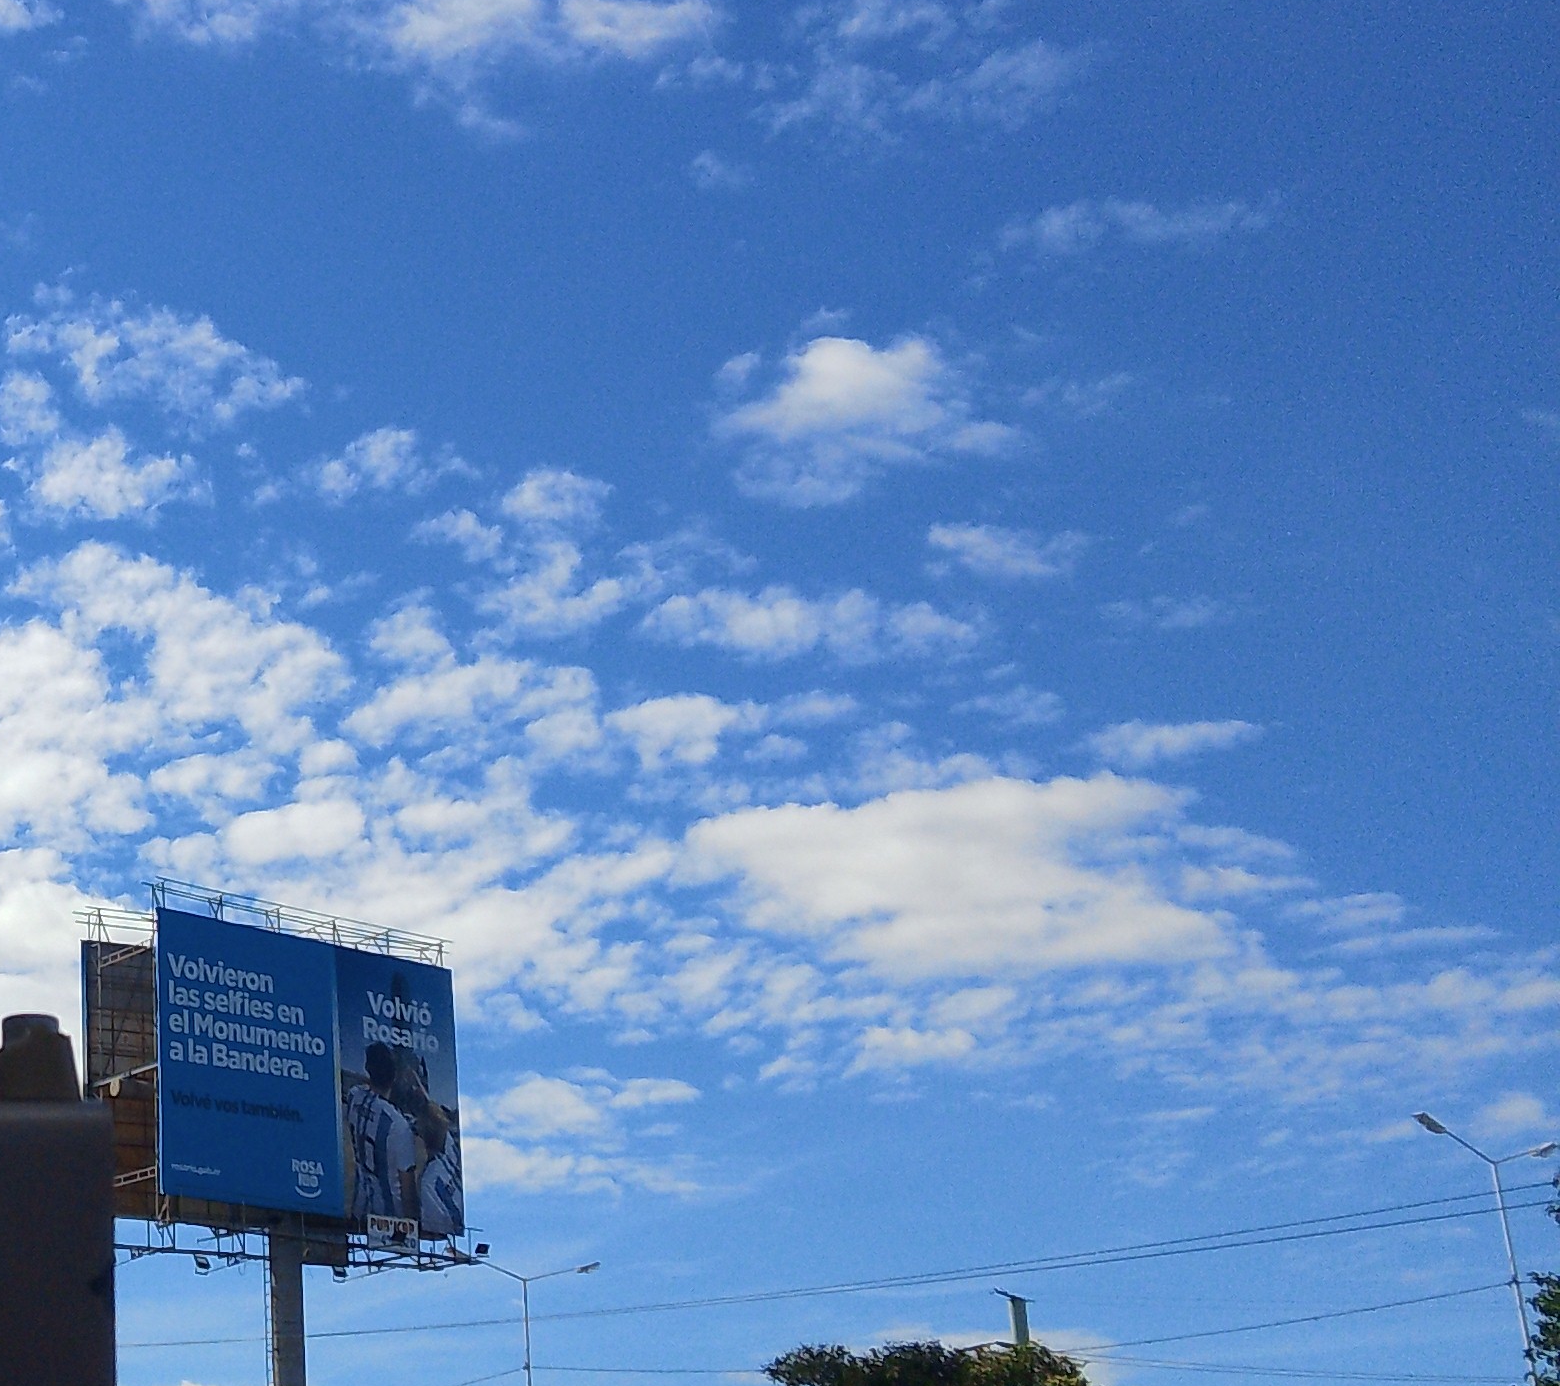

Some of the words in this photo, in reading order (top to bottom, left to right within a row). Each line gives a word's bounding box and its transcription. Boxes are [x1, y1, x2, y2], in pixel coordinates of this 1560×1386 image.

[167, 952, 274, 994] Volvieron
[168, 979, 200, 1008] las
[204, 989, 274, 1021] selfies
[277, 1004, 305, 1026] en
[366, 990, 433, 1026] Volvió
[168, 1009, 189, 1034] el
[193, 1012, 326, 1056] Monumento
[362, 1015, 439, 1052] Rosario
[169, 1040, 184, 1062] a
[188, 1038, 208, 1065] la
[212, 1042, 310, 1081] Bandera.
[170, 1089, 212, 1111] Volvé
[214, 1098, 239, 1114] vos
[291, 1158, 324, 1176] ROSA
